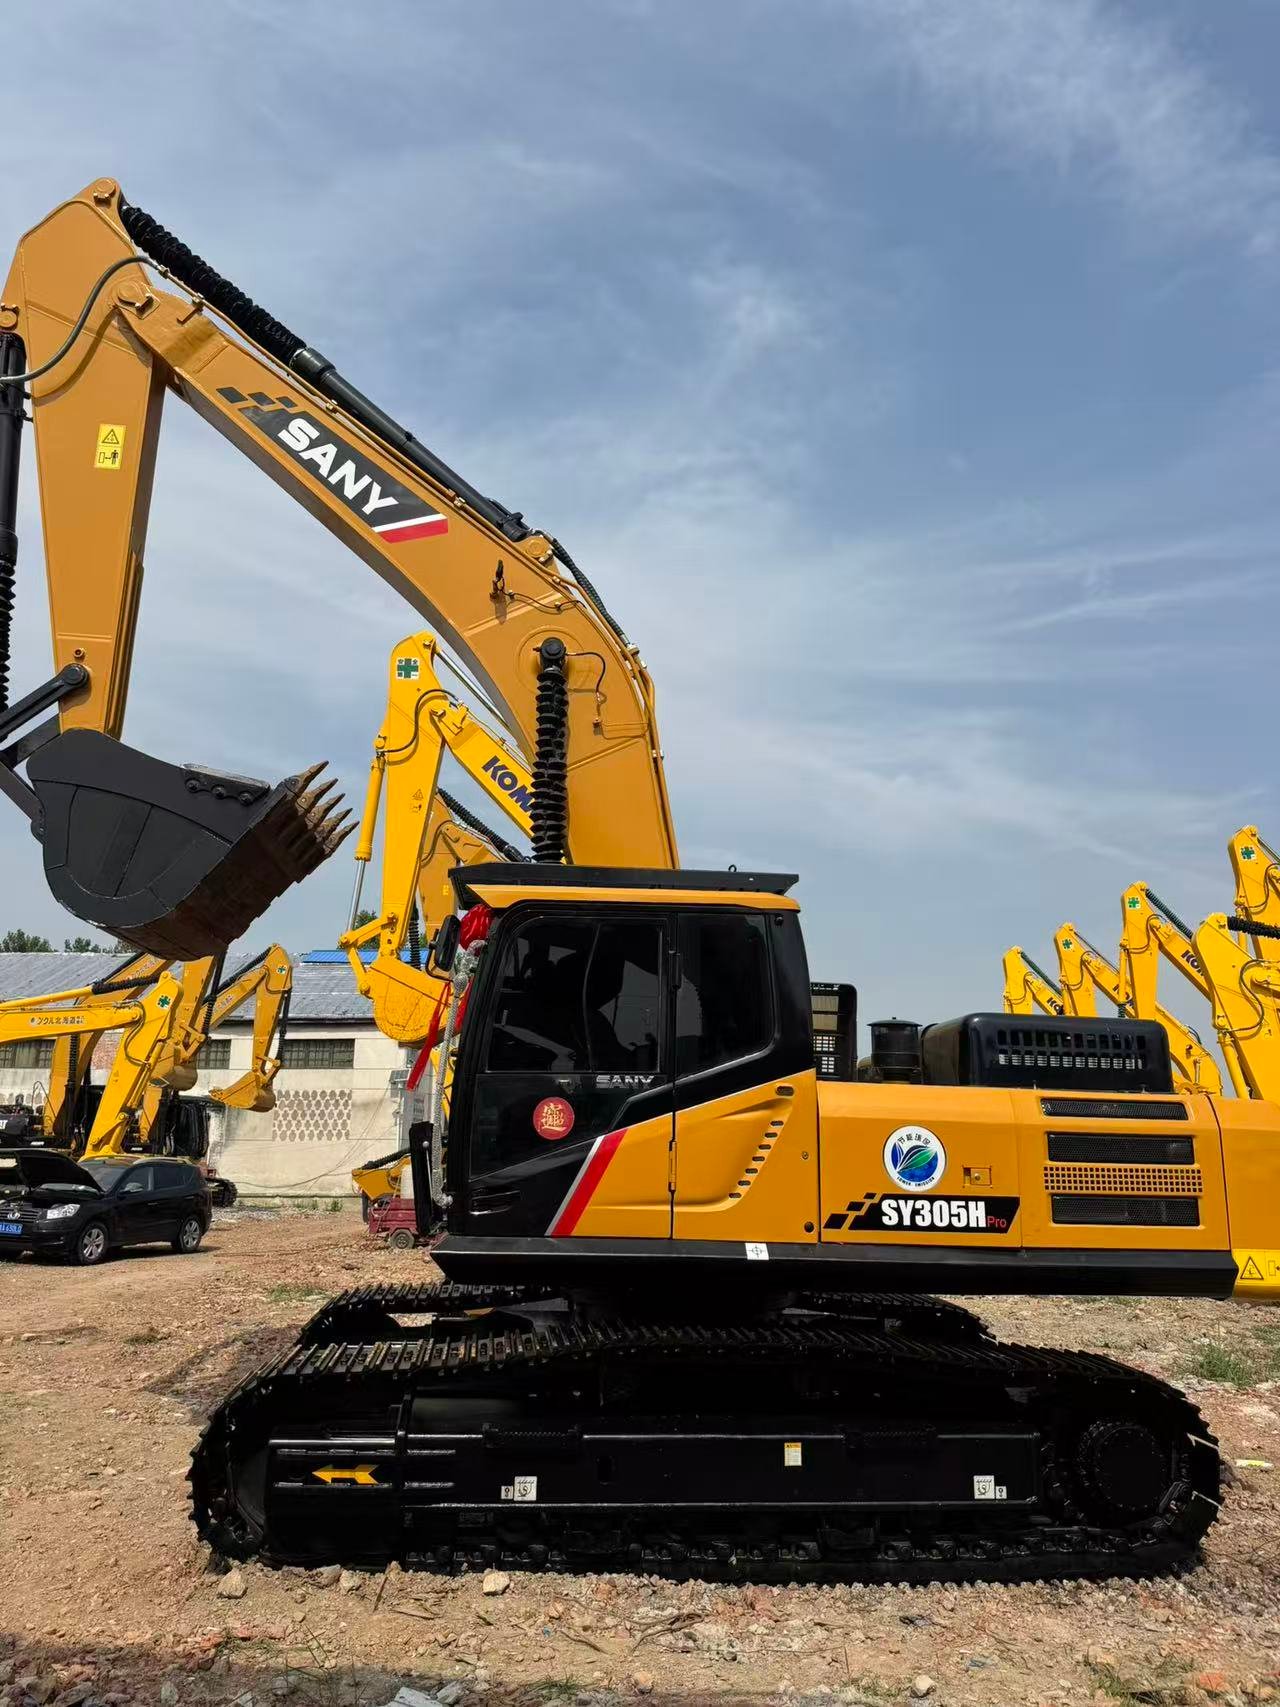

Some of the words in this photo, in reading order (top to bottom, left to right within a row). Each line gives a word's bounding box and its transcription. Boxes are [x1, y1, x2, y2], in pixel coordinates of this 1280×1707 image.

[277, 418, 399, 515] SANY
[596, 1075, 654, 1089] SANY
[881, 1199, 986, 1228] SY305H
[987, 1216, 1007, 1229] Pro
